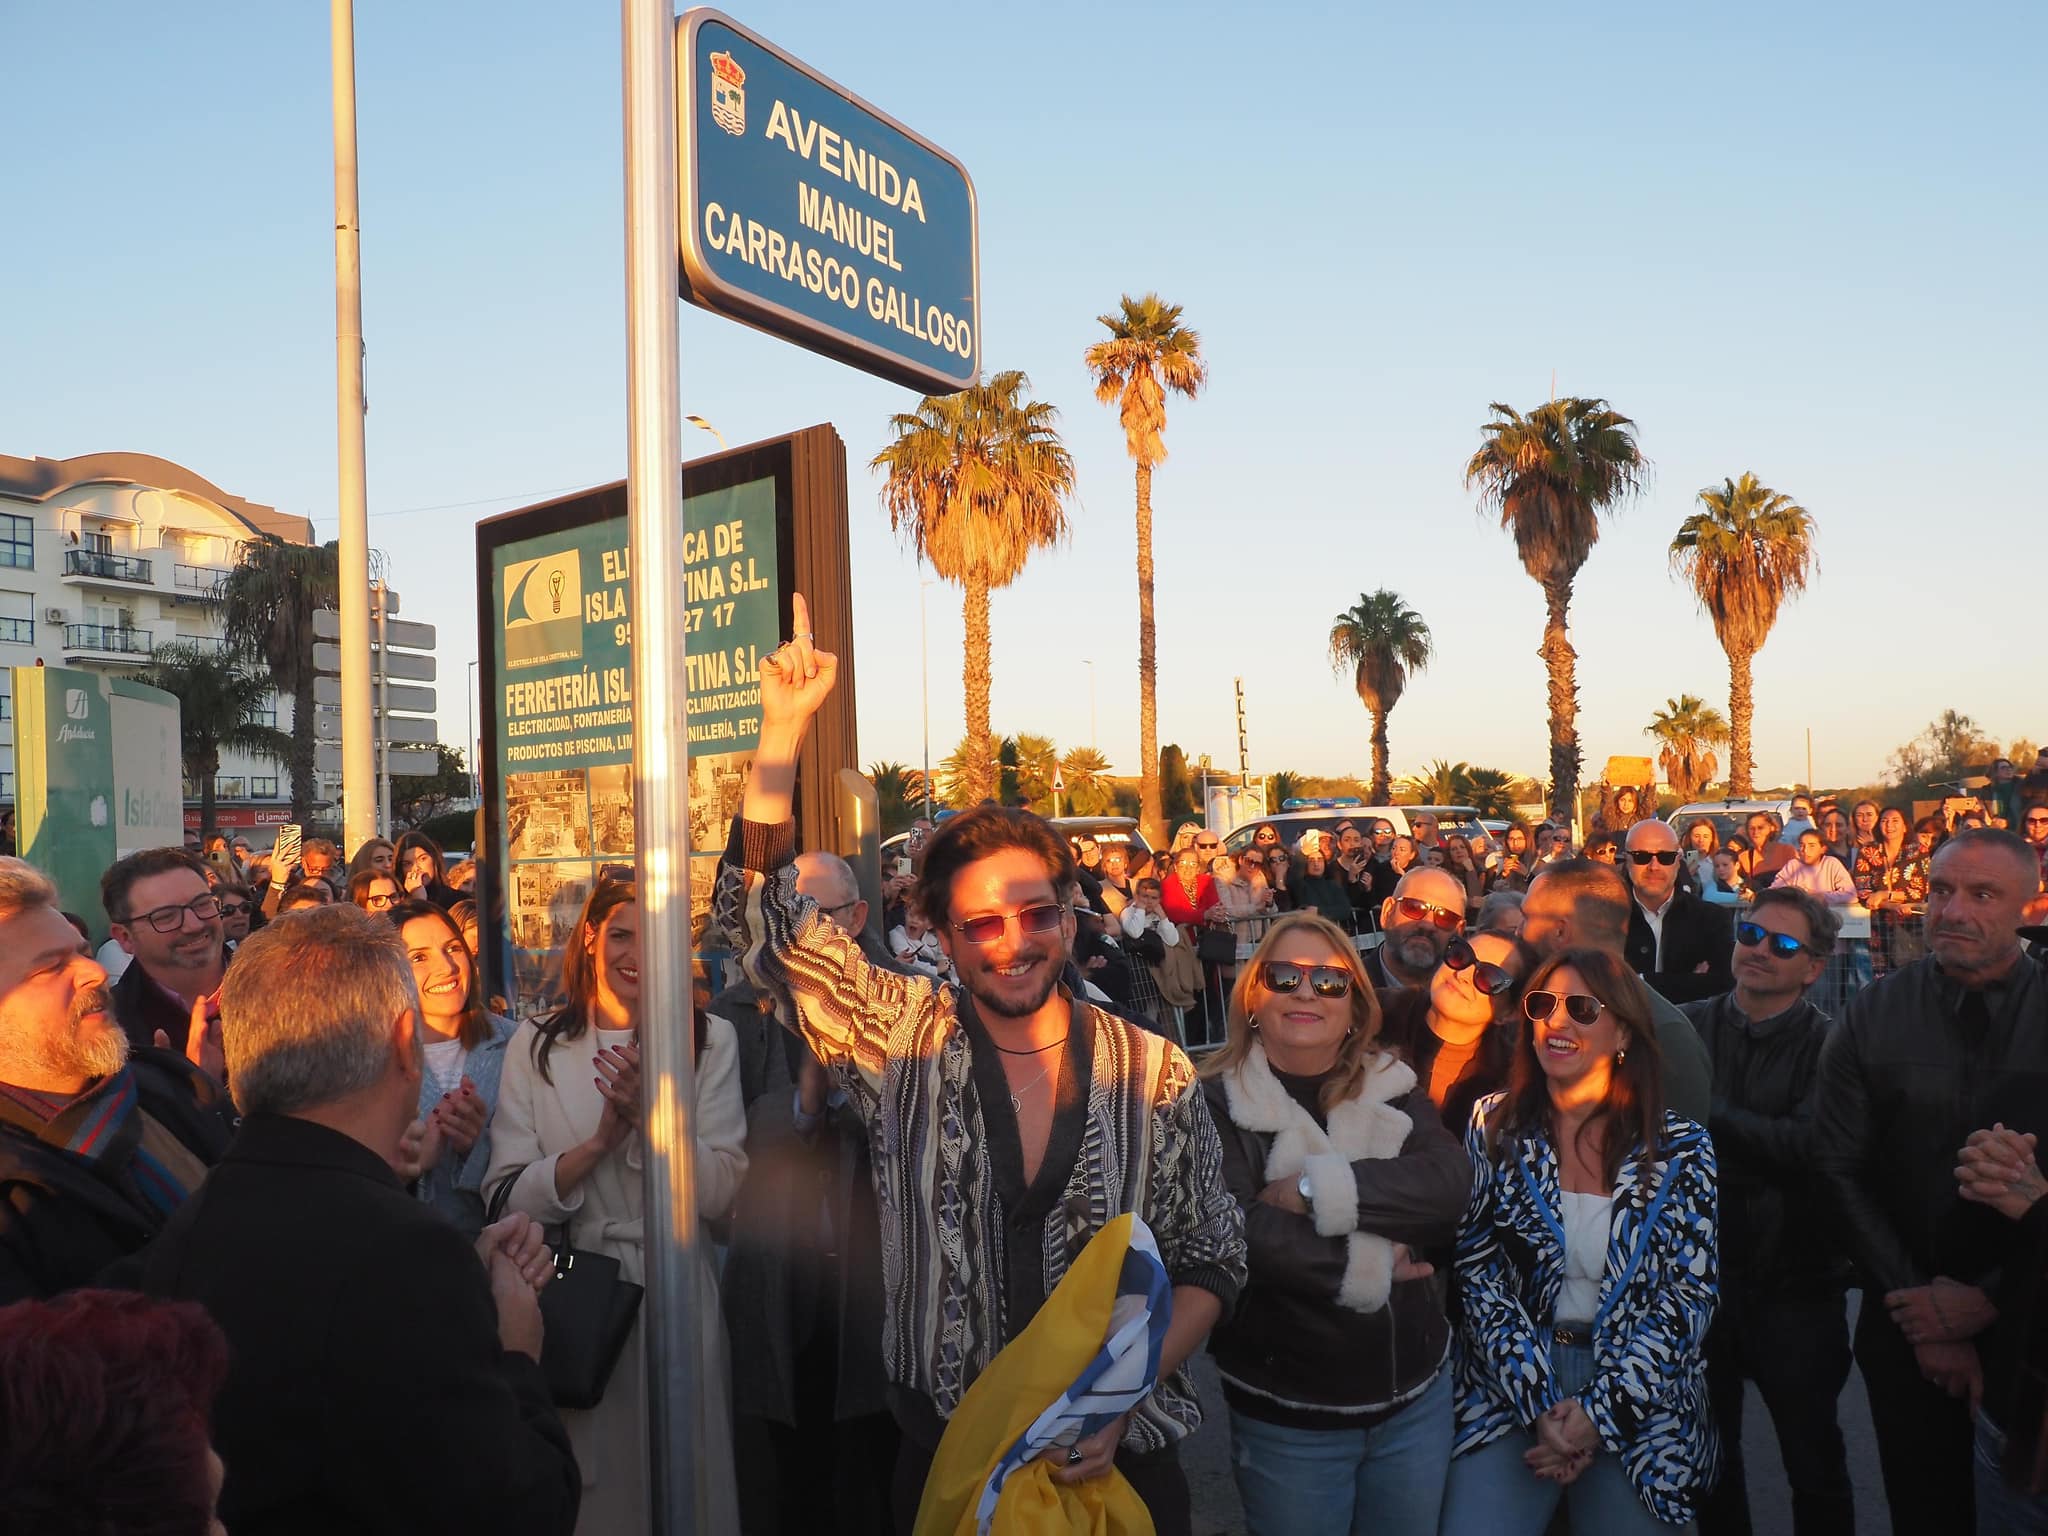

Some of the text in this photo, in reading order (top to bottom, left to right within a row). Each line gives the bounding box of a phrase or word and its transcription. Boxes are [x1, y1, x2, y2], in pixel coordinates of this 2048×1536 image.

[765, 100, 926, 223] AVENIDA
[799, 182, 902, 271] MANUEL
[705, 202, 971, 359] CARRASCO GALLOSO
[714, 520, 743, 557] DE
[585, 587, 627, 624] ISLA
[730, 558, 768, 594] S.L.
[712, 602, 735, 627] 17
[506, 664, 600, 718] FERRETERÍA
[603, 667, 632, 704] ISL
[507, 742, 563, 762] PRODUCTOS
[564, 741, 575, 756] DE
[576, 736, 615, 755] PISCINA,
[687, 718, 737, 742] NILLERÍA,
[739, 718, 758, 735] ETC
[508, 715, 573, 737] ELECTRICIDAD,
[257, 811, 289, 823] el jamón
